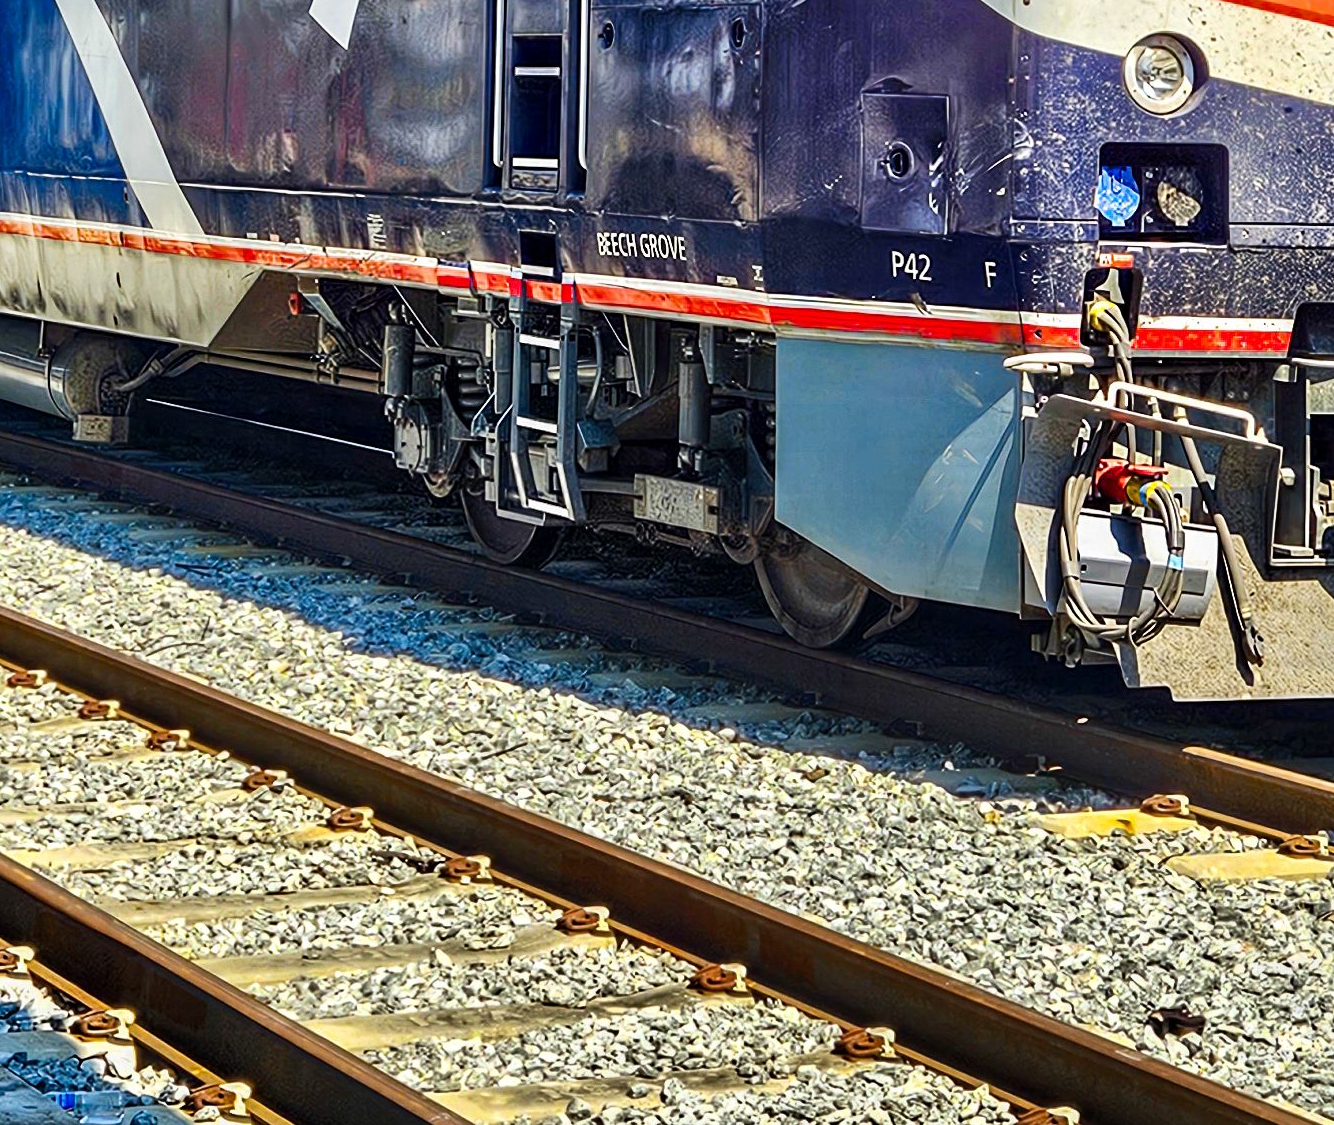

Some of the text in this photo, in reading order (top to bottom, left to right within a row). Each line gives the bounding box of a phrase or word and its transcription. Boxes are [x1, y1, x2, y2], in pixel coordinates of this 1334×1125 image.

[597, 232, 687, 261] BEECH GROVE
[891, 250, 997, 288] P42 F
